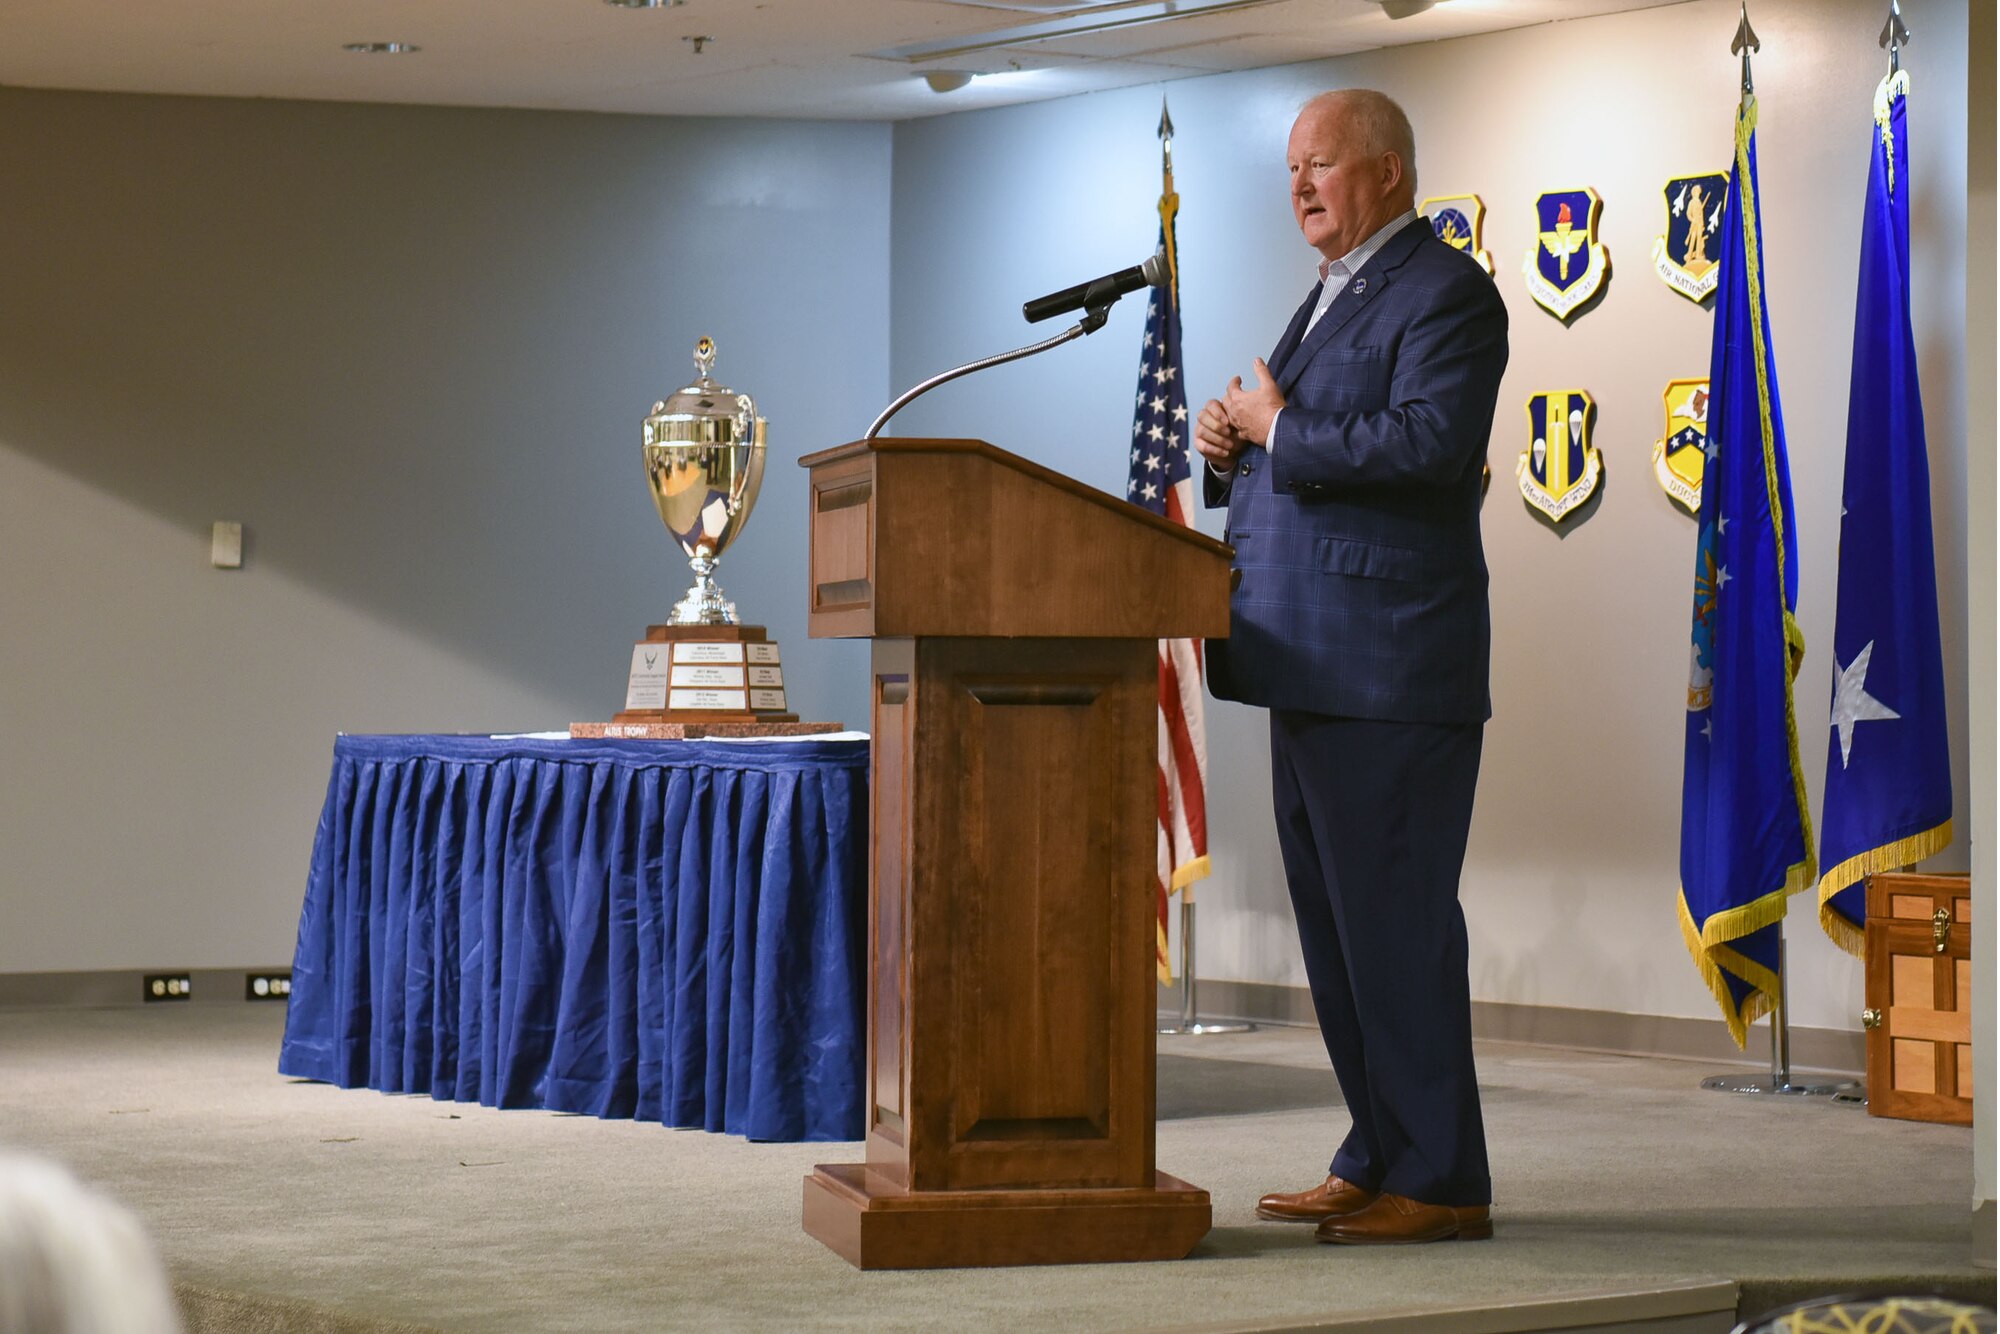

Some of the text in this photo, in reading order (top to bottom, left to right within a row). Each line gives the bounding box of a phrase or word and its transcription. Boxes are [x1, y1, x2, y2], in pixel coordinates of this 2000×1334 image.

[1659, 264, 1672, 278] AIR
[1674, 274, 1712, 297] NATIONAL
[624, 726, 648, 737] TROPHY
